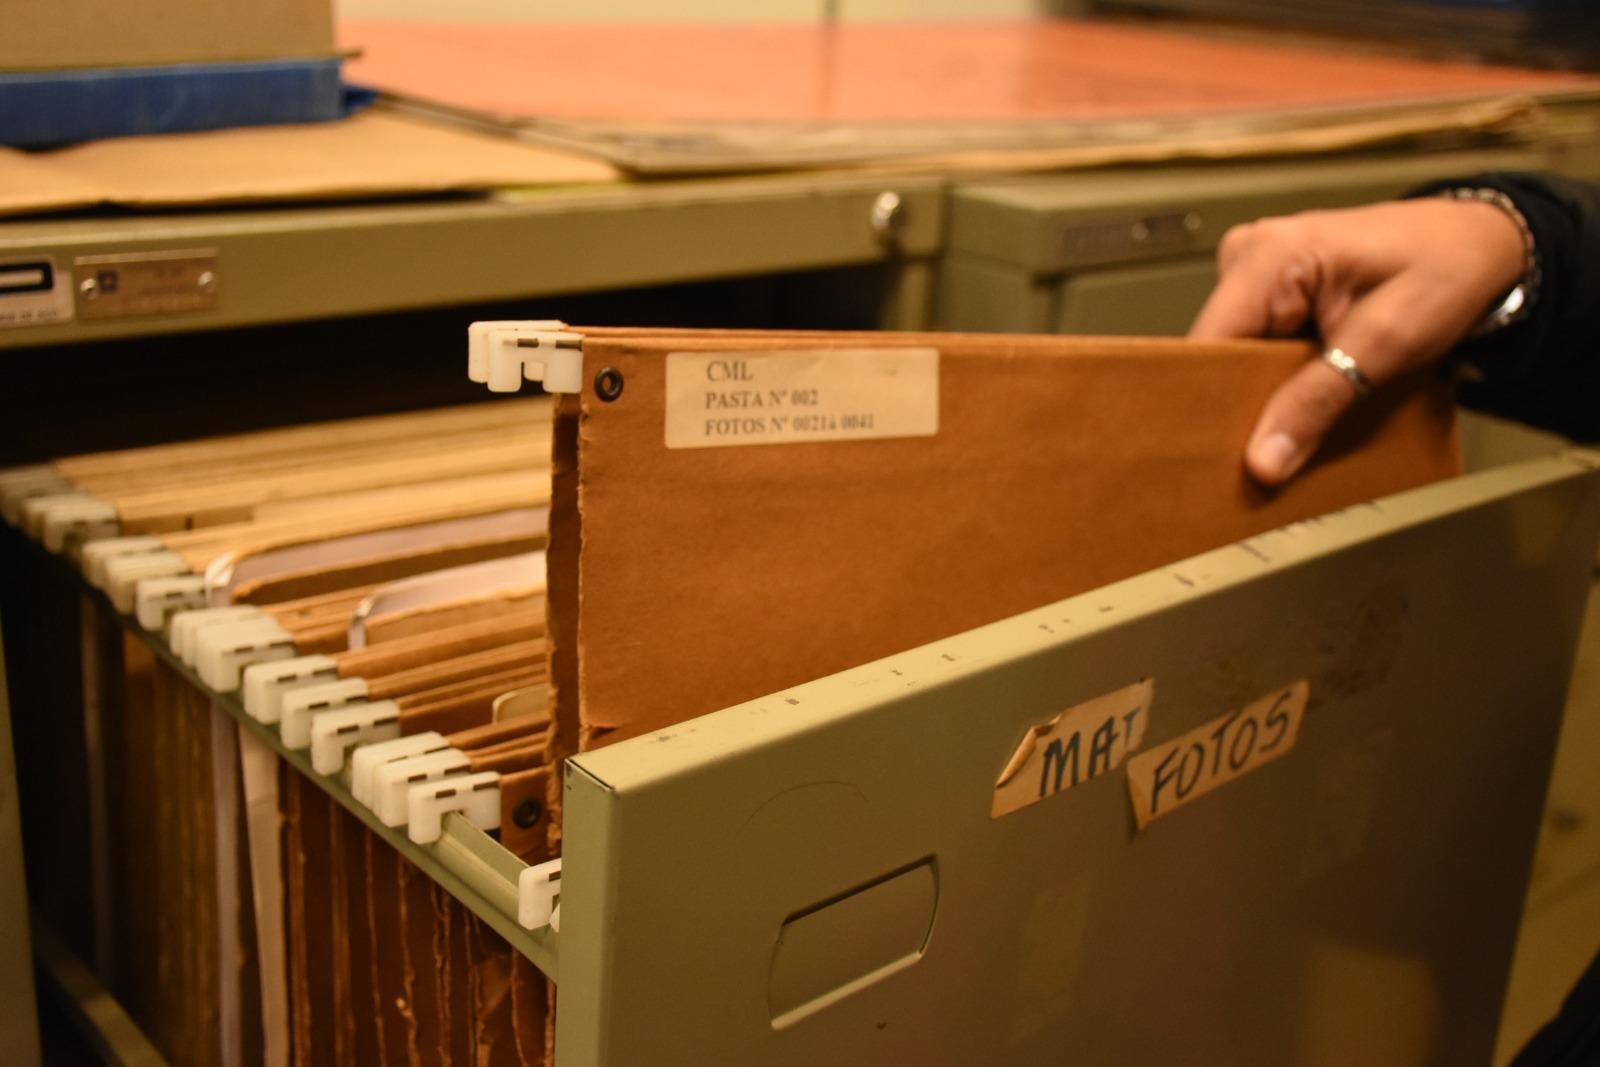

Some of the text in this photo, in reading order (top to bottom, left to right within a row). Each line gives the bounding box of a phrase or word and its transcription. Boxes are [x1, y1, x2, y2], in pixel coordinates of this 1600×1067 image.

[706, 361, 753, 383] CML
[705, 389, 764, 410] PASTA
[791, 388, 819, 407] 002
[705, 417, 766, 437] FOTOS
[1151, 690, 1292, 814] FOTOS
